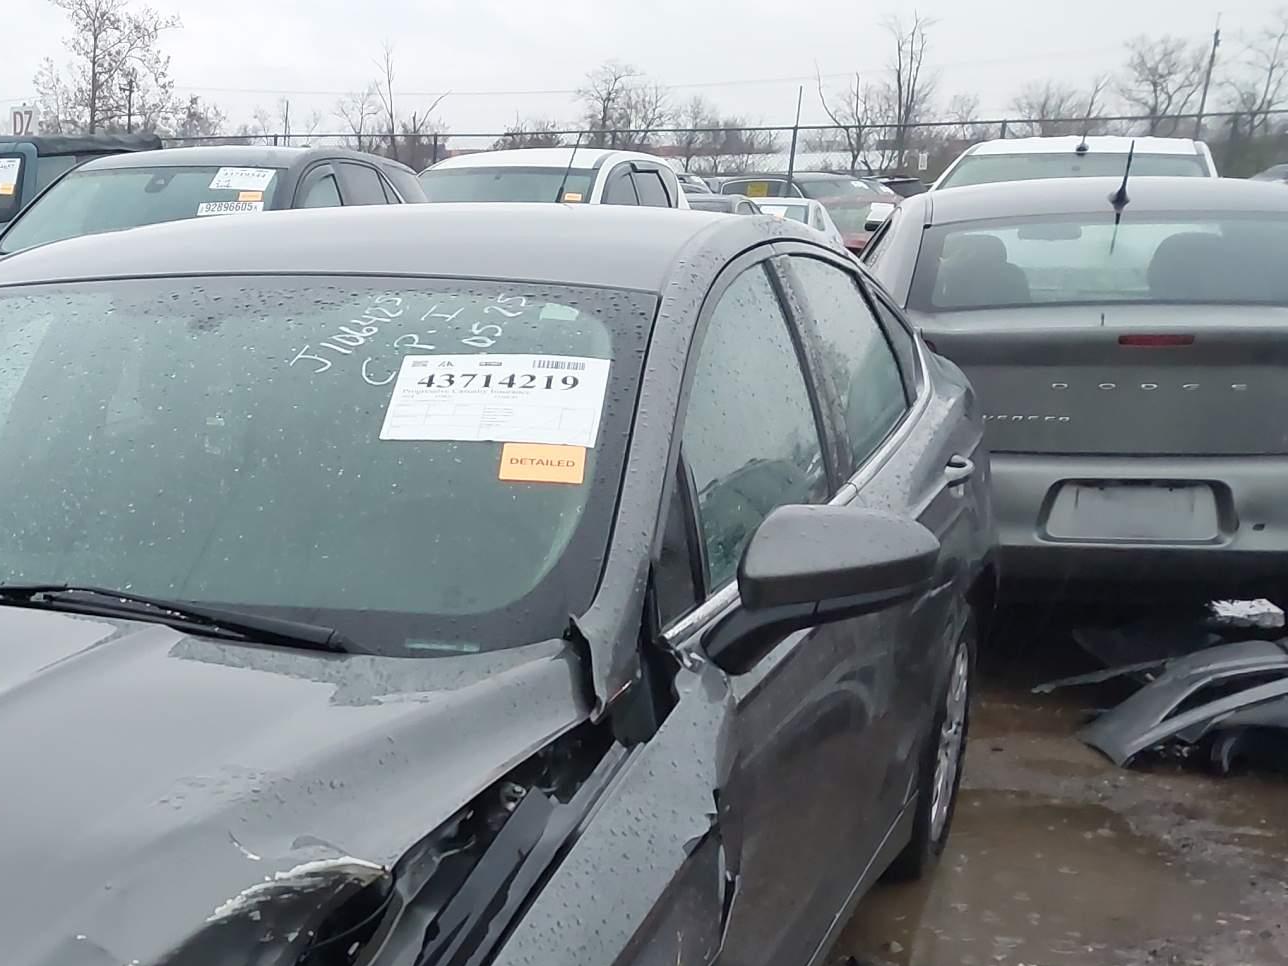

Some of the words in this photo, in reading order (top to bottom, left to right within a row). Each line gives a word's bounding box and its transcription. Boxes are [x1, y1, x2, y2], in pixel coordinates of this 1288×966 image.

[13, 111, 33, 136] DZ
[417, 373, 580, 391] 43714219
[510, 457, 575, 468] DETAILED
